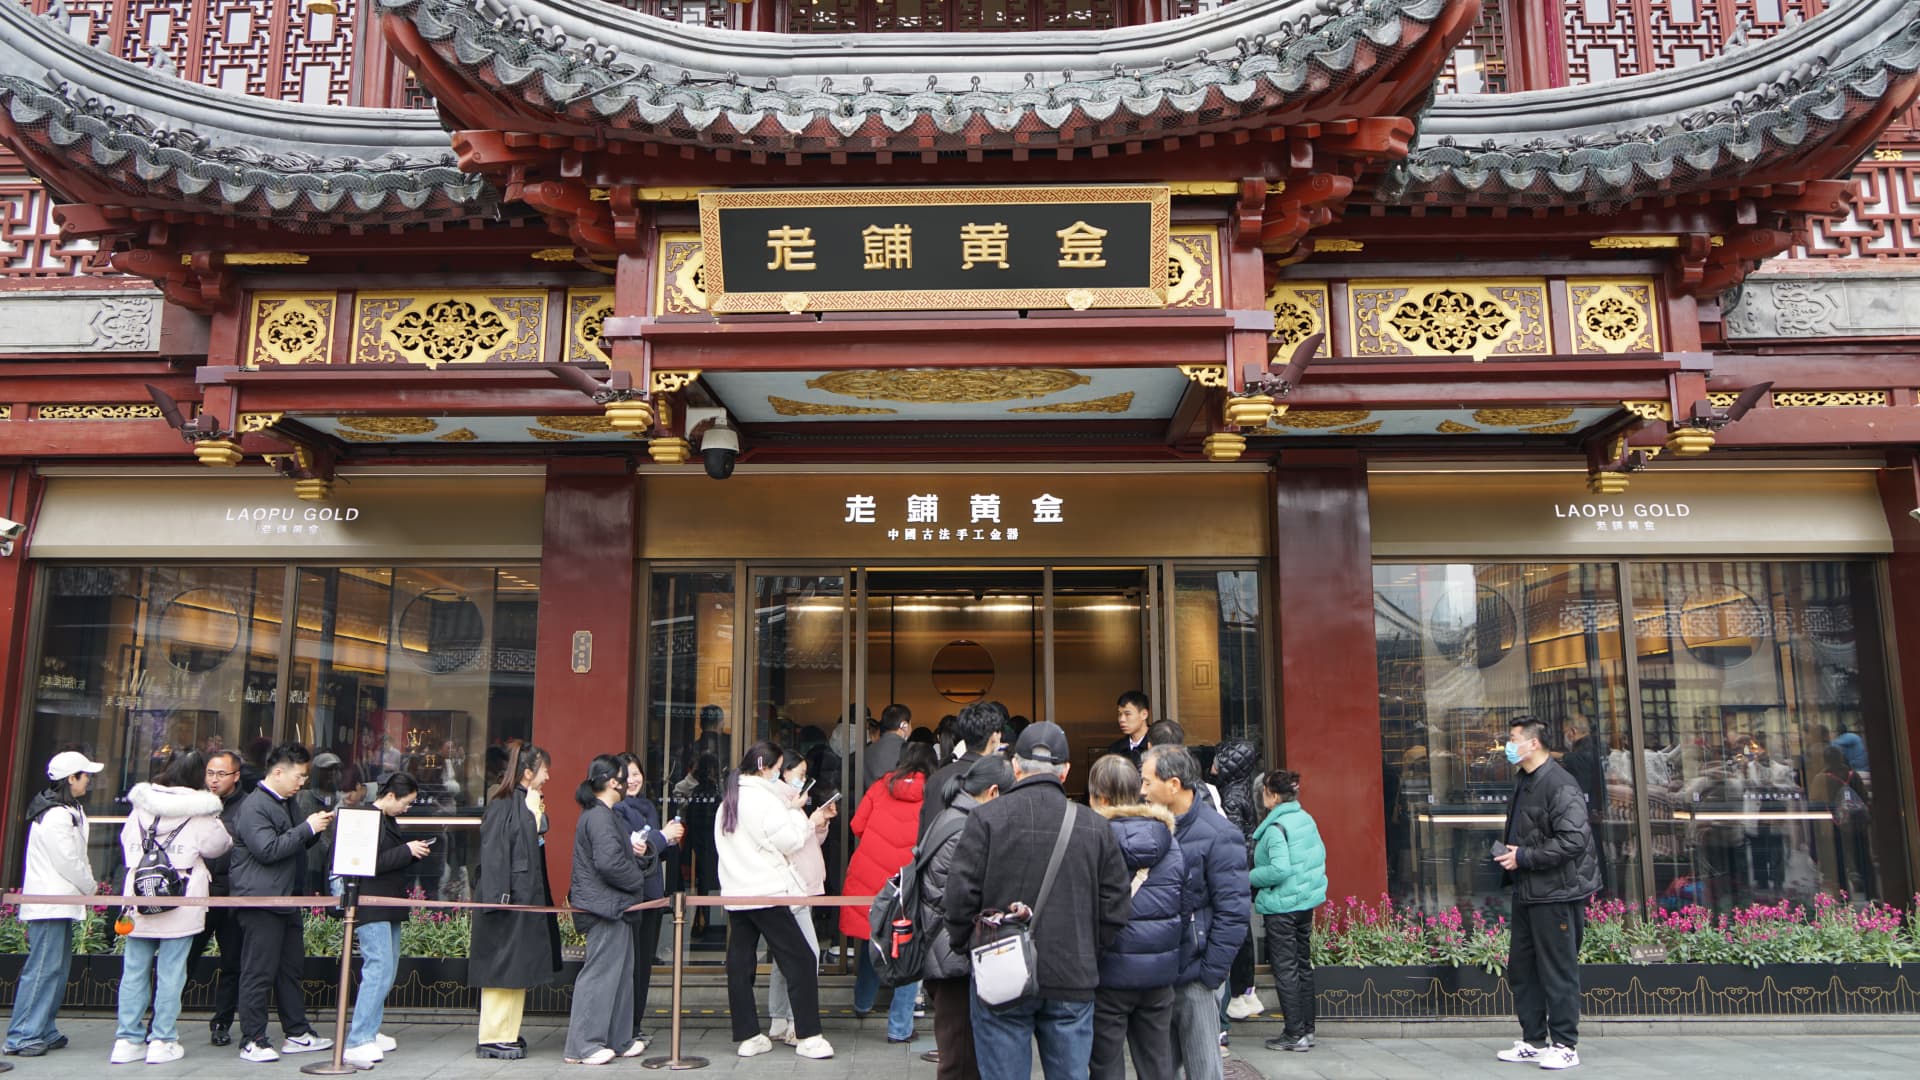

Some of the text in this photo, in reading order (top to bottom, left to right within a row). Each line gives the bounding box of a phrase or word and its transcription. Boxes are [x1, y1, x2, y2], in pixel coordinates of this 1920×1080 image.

[225, 508, 359, 521] LAOPU GOLD
[1554, 504, 1690, 518] LAOPU GOLD
